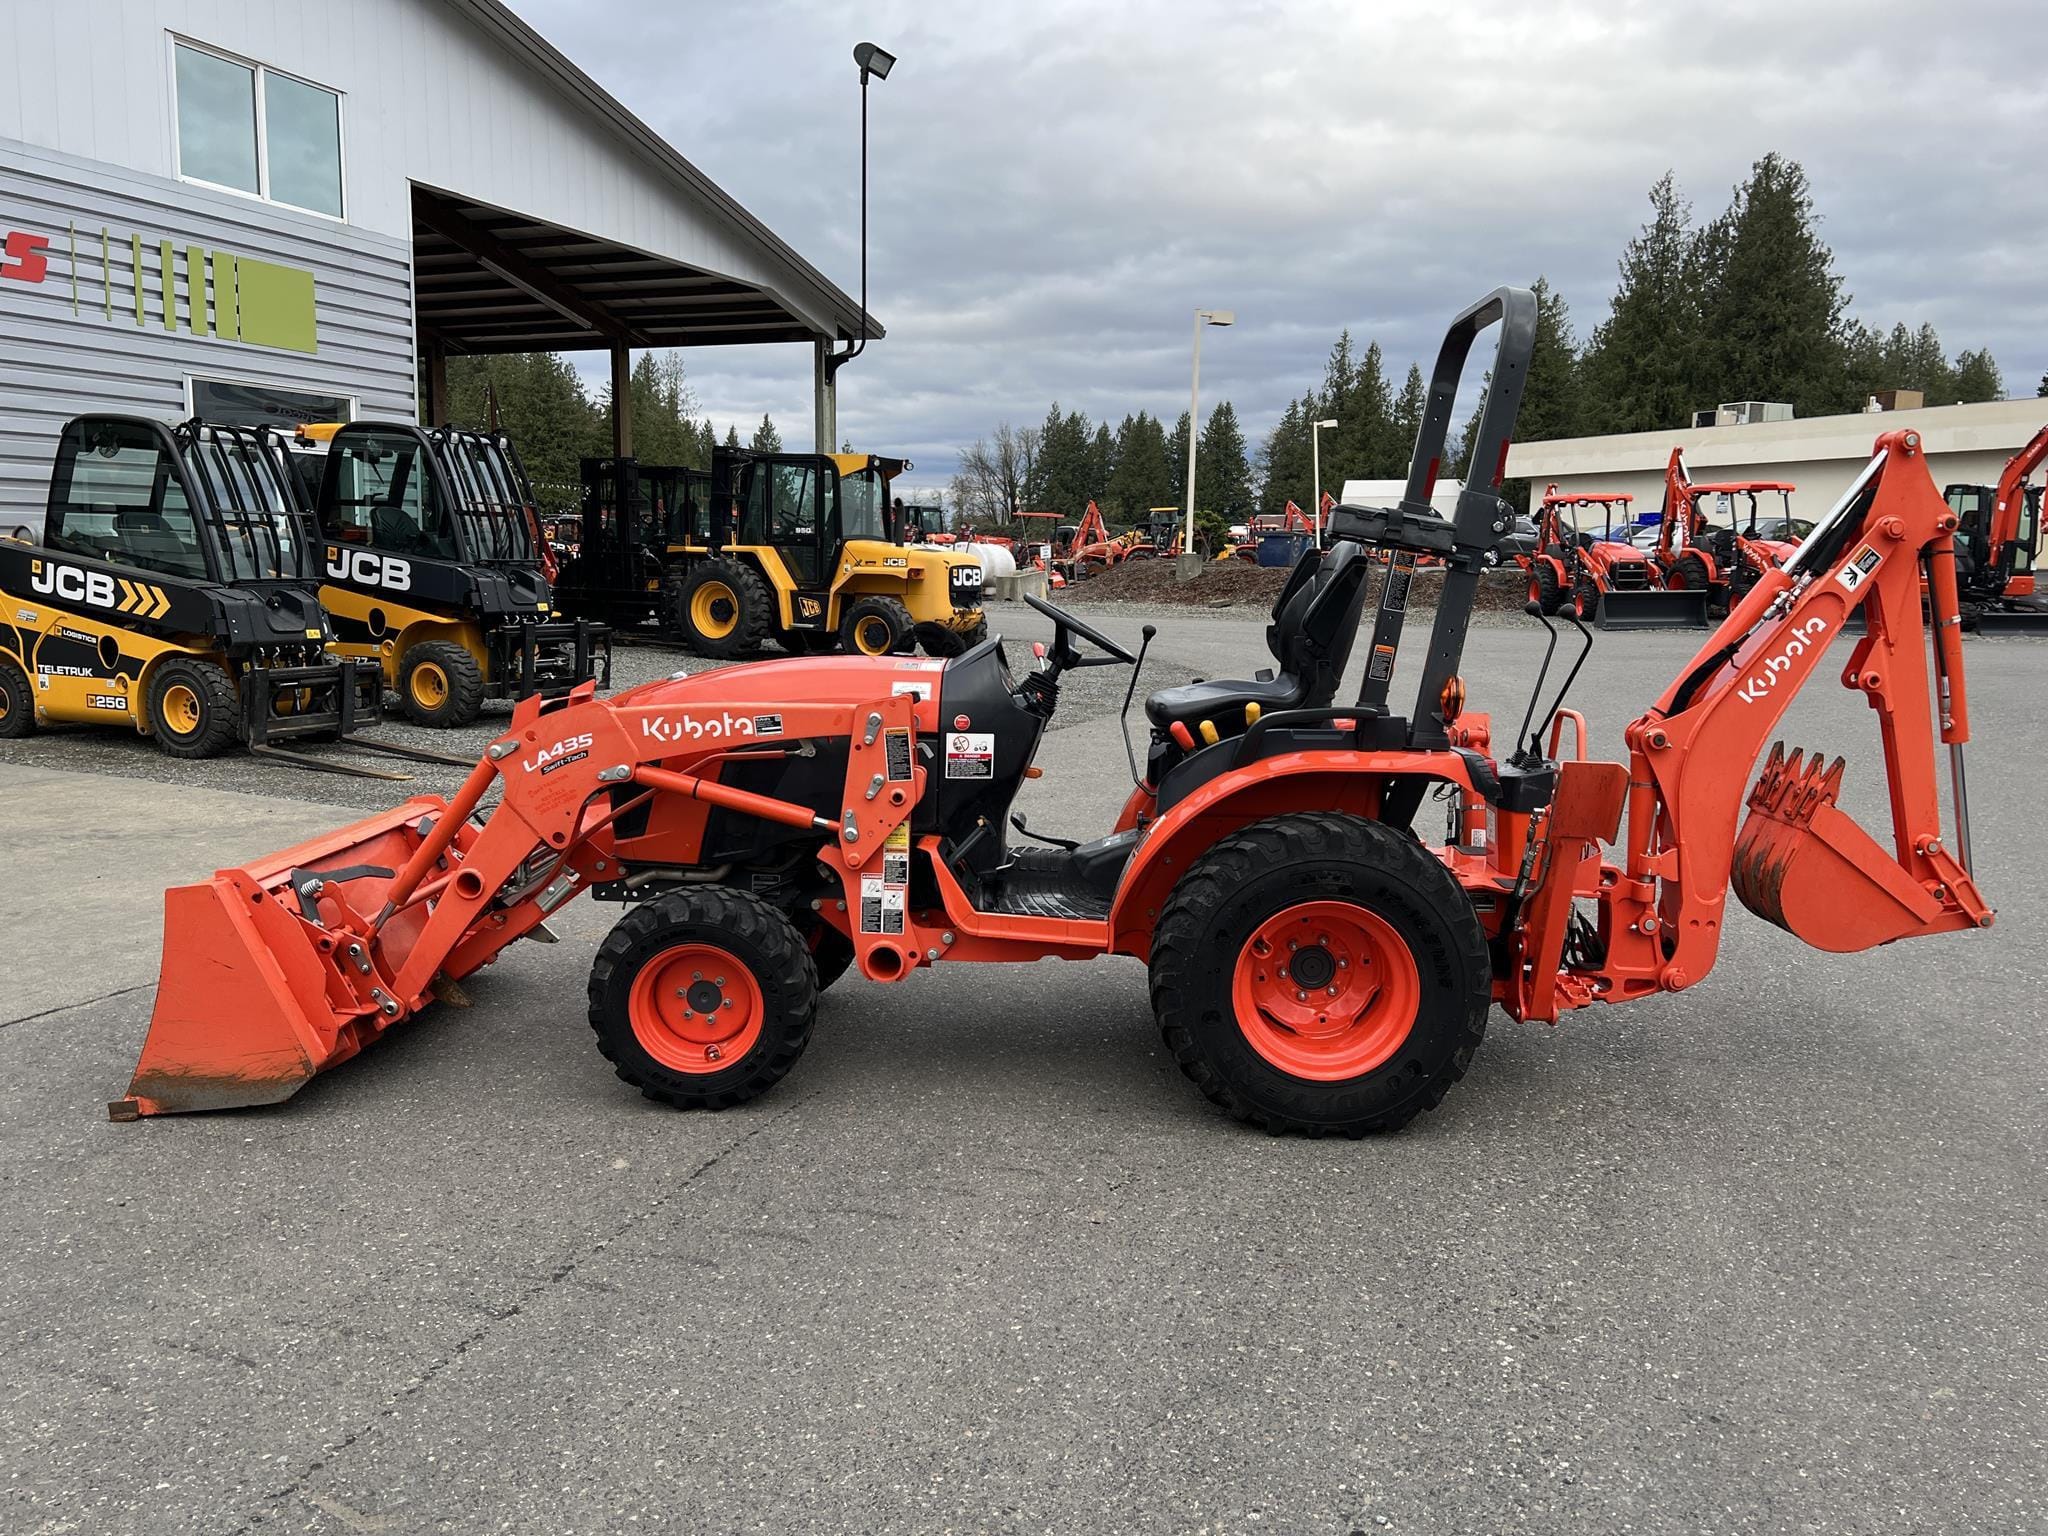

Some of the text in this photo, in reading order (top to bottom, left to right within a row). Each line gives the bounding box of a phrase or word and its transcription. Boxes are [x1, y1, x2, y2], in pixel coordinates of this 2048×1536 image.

[327, 549, 411, 591] JCB
[883, 558, 907, 567] JCB
[31, 562, 115, 608] JCB
[953, 568, 982, 587] JCB
[802, 598, 820, 616] JCB
[62, 629, 97, 644] LOGISTICS
[38, 664, 93, 677] TELETRUK
[1737, 617, 1827, 704] Kubota
[96, 696, 126, 709] 25G
[641, 711, 754, 741] Kubota
[522, 732, 593, 772] LA435
[543, 751, 587, 774] Swift-Tach
